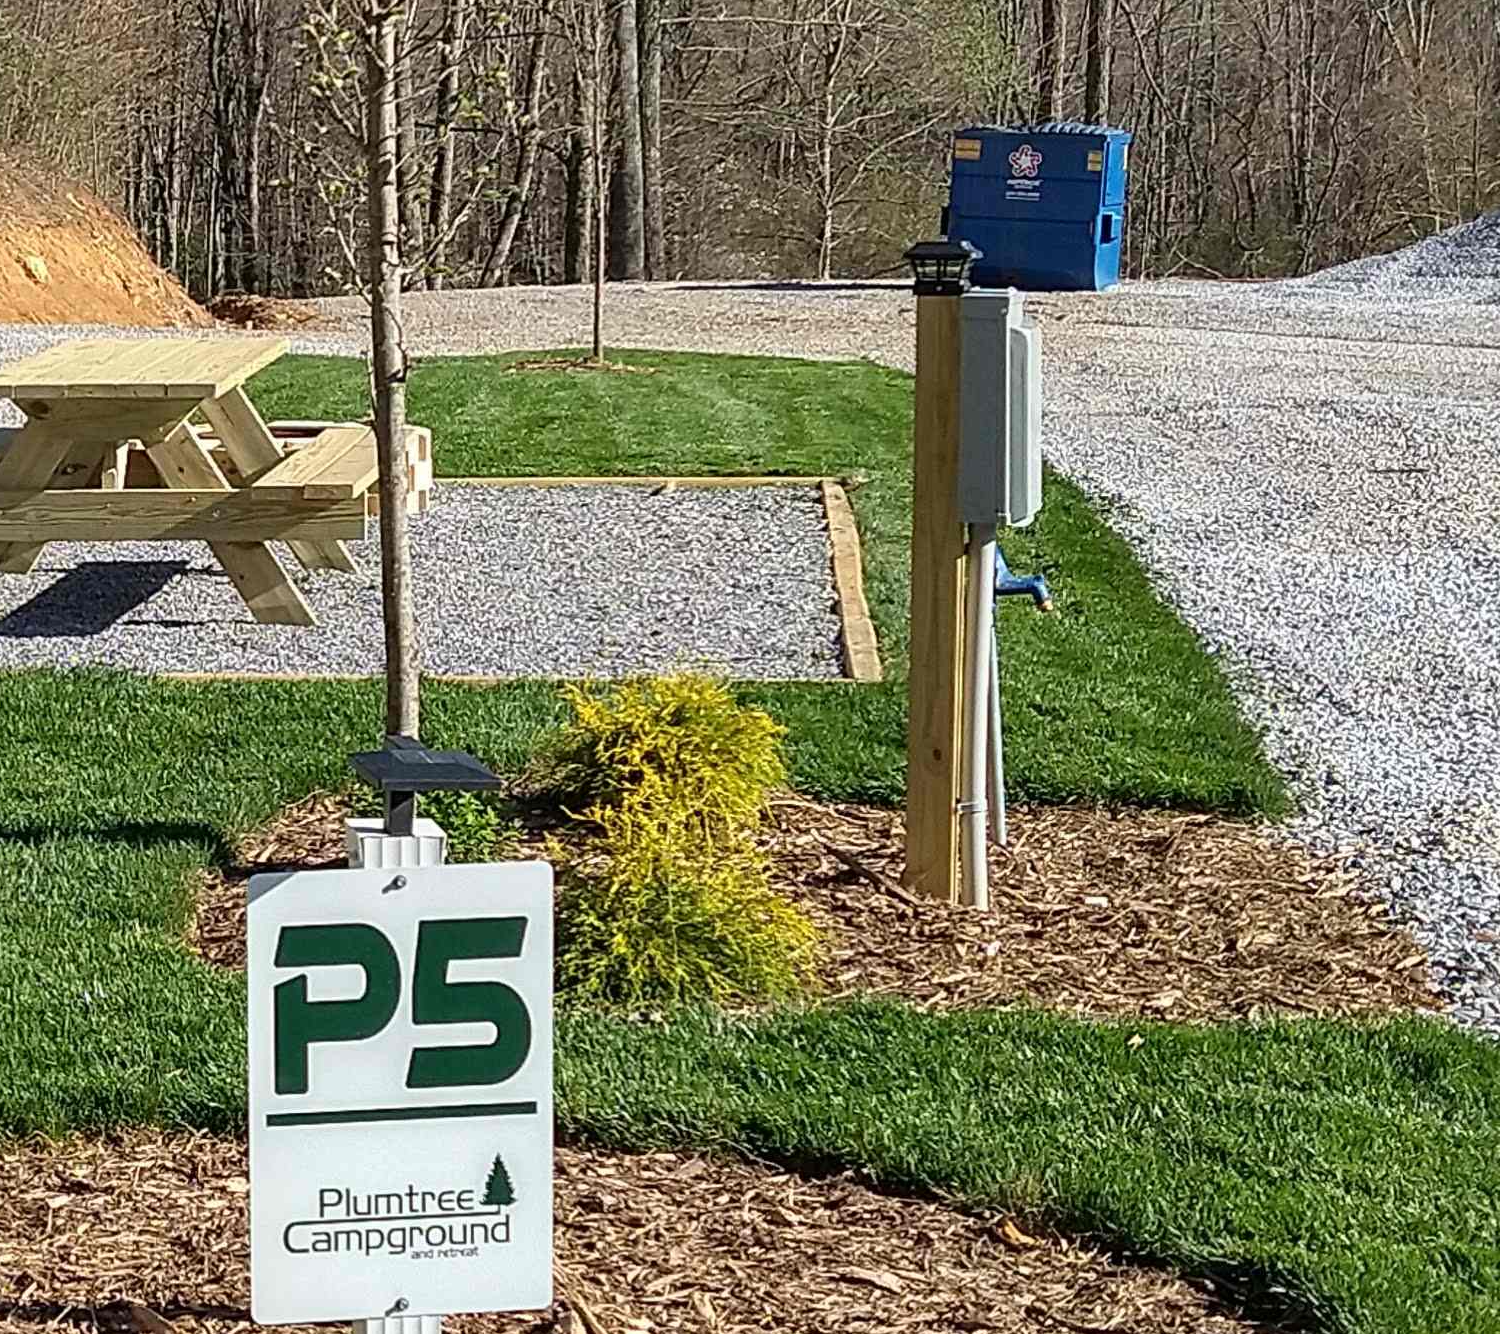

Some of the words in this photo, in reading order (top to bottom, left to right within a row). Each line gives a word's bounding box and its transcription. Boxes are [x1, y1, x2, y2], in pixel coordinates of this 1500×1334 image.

[274, 916, 532, 1095] P5
[319, 1184, 475, 1218] Plumtree
[283, 1214, 511, 1256] Campground
[411, 1249, 434, 1259] and
[437, 1246, 479, 1258] retreat
